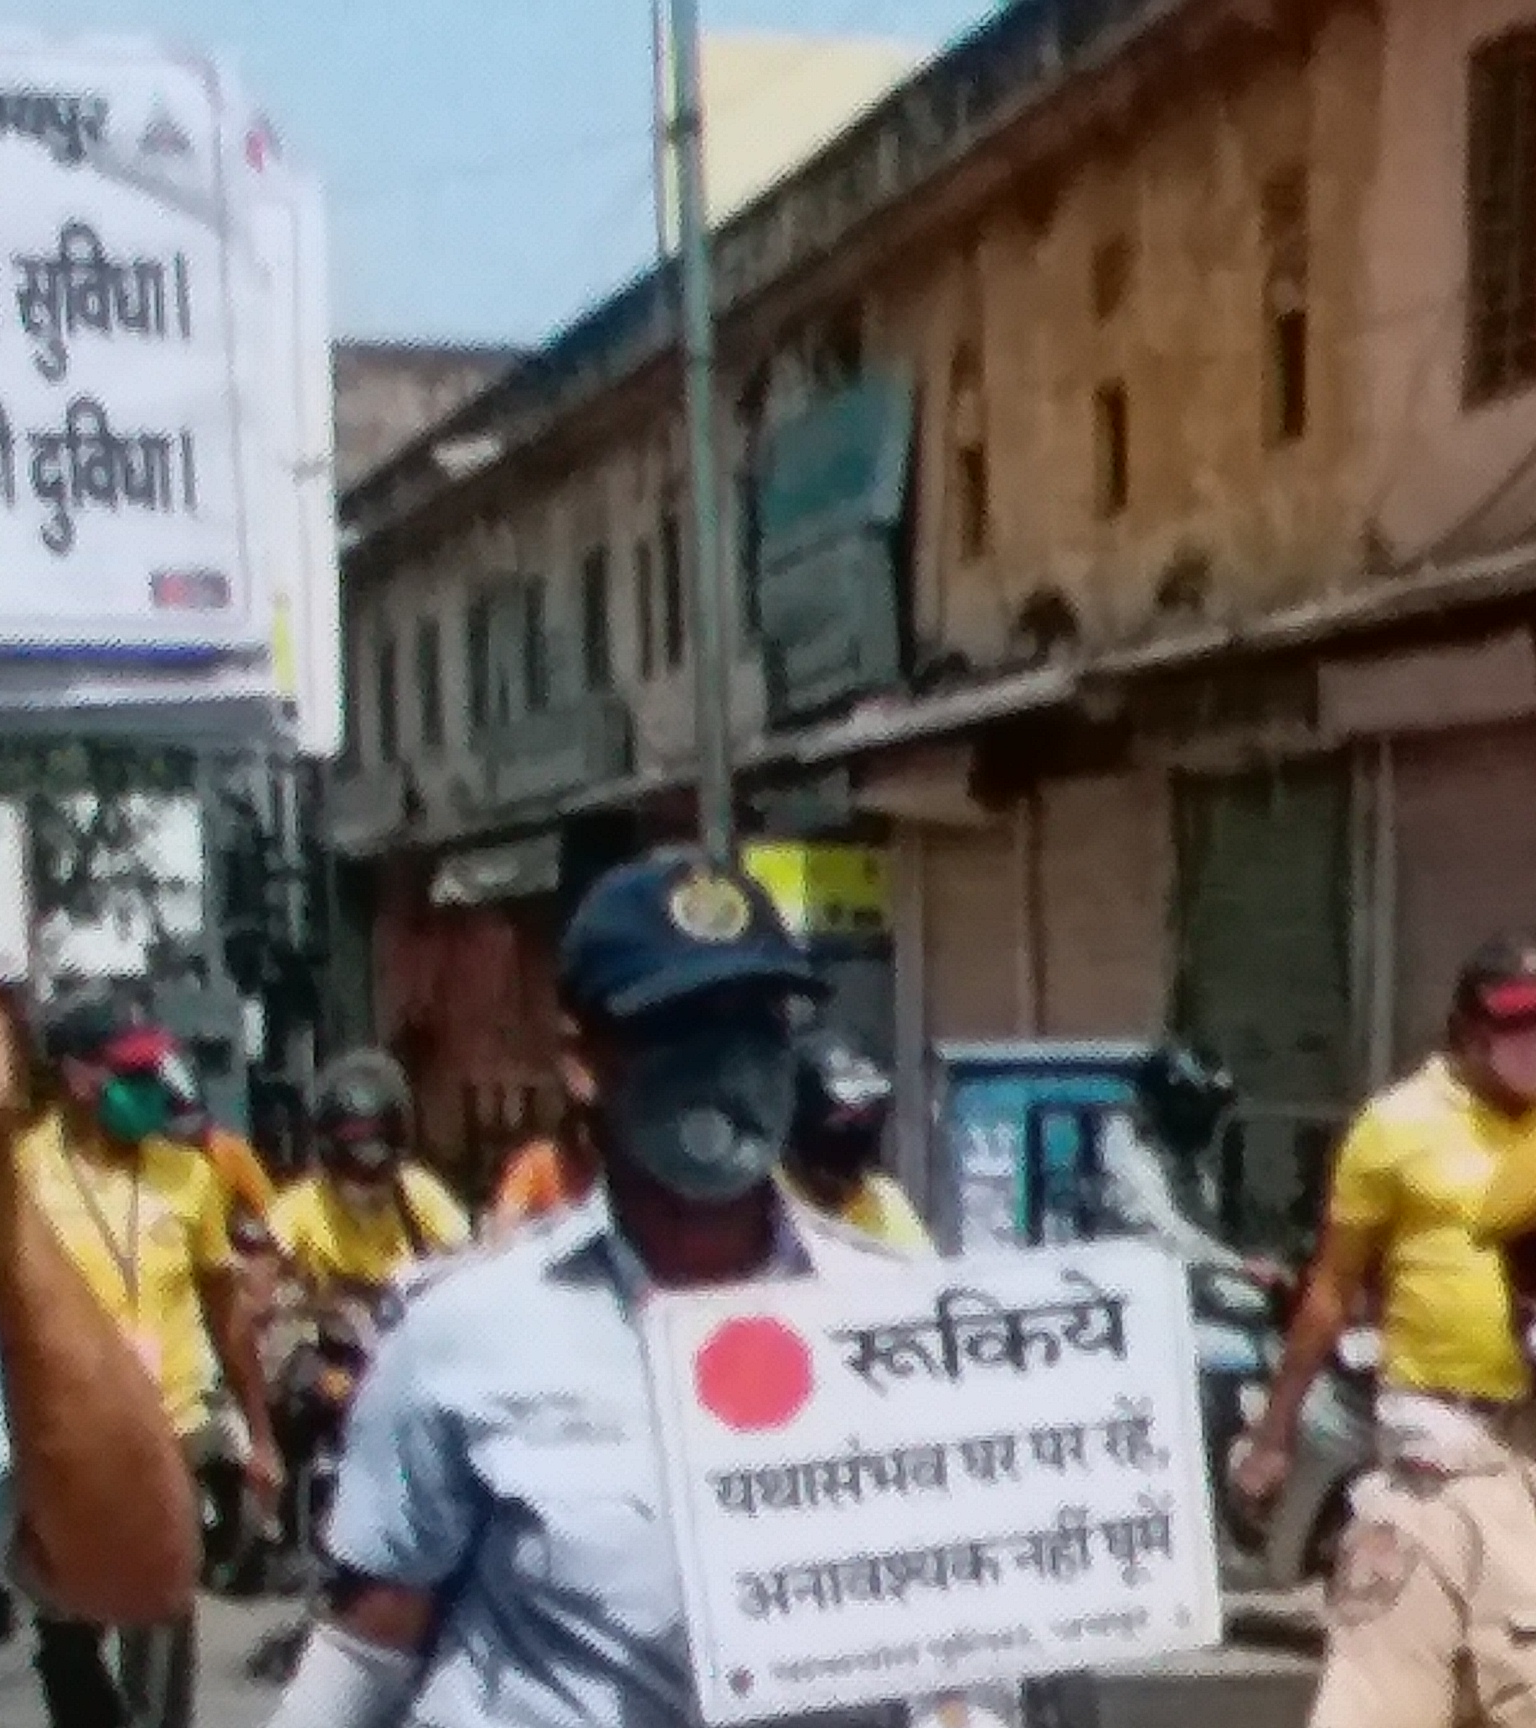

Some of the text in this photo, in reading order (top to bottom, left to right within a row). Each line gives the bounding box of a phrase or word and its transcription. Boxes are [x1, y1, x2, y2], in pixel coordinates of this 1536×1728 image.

[12, 221, 191, 383] सुविधा।
[28, 394, 197, 556] दुविधा।
[1009, 1505, 1091, 1581] नहीं
